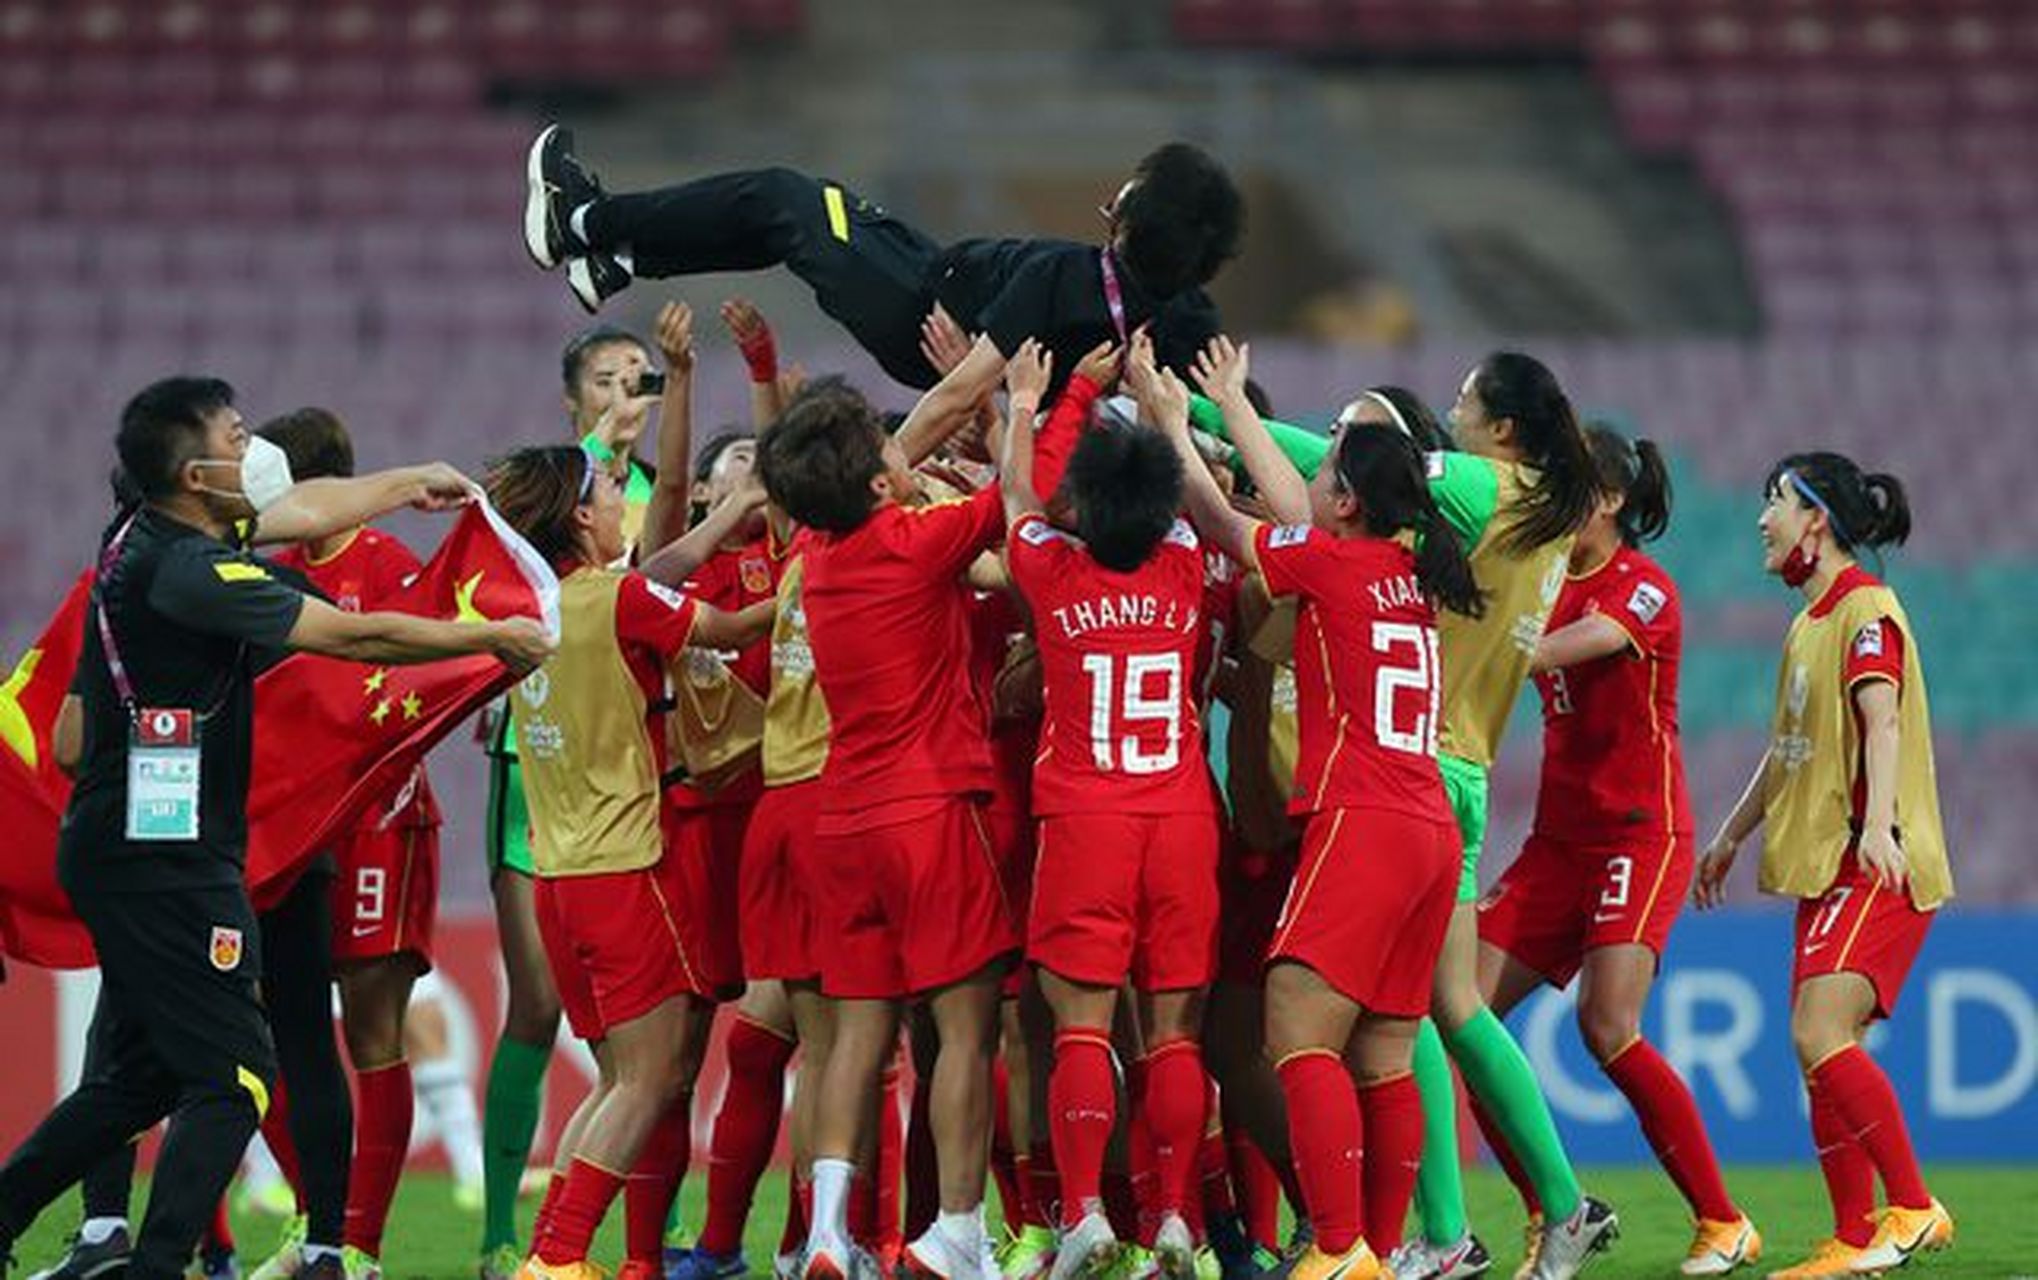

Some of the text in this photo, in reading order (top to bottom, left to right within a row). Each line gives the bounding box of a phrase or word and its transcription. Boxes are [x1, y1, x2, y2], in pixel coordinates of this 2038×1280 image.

[1053, 595, 1158, 638] ZHANG
[1083, 651, 1180, 773] 19
[1371, 620, 1440, 758] 21
[355, 868, 386, 919] 9
[1601, 856, 1633, 906] 3
[1523, 967, 2038, 1123] CRD
